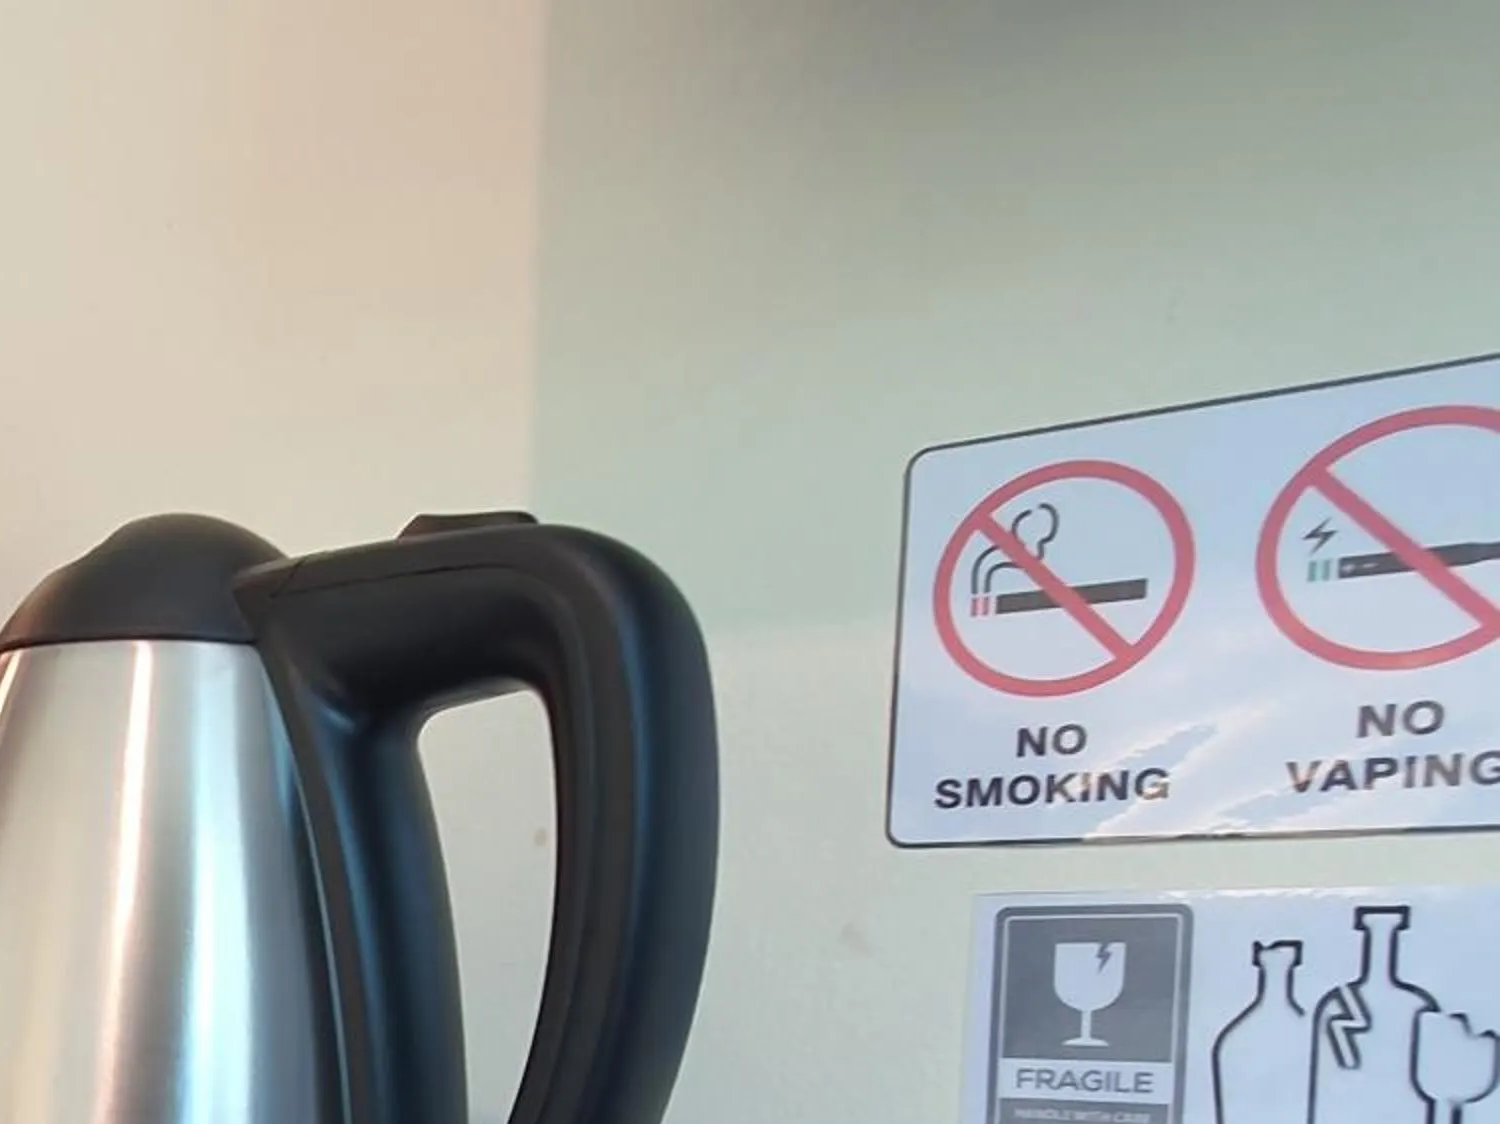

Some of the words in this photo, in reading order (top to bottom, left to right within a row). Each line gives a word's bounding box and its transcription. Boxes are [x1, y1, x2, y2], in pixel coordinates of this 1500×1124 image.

[1356, 699, 1446, 739] NO
[1015, 723, 1088, 759] NO
[933, 766, 1171, 811] SMOKING
[1285, 749, 1500, 794] VAPING
[1015, 1067, 1155, 1094] FRAGILE
